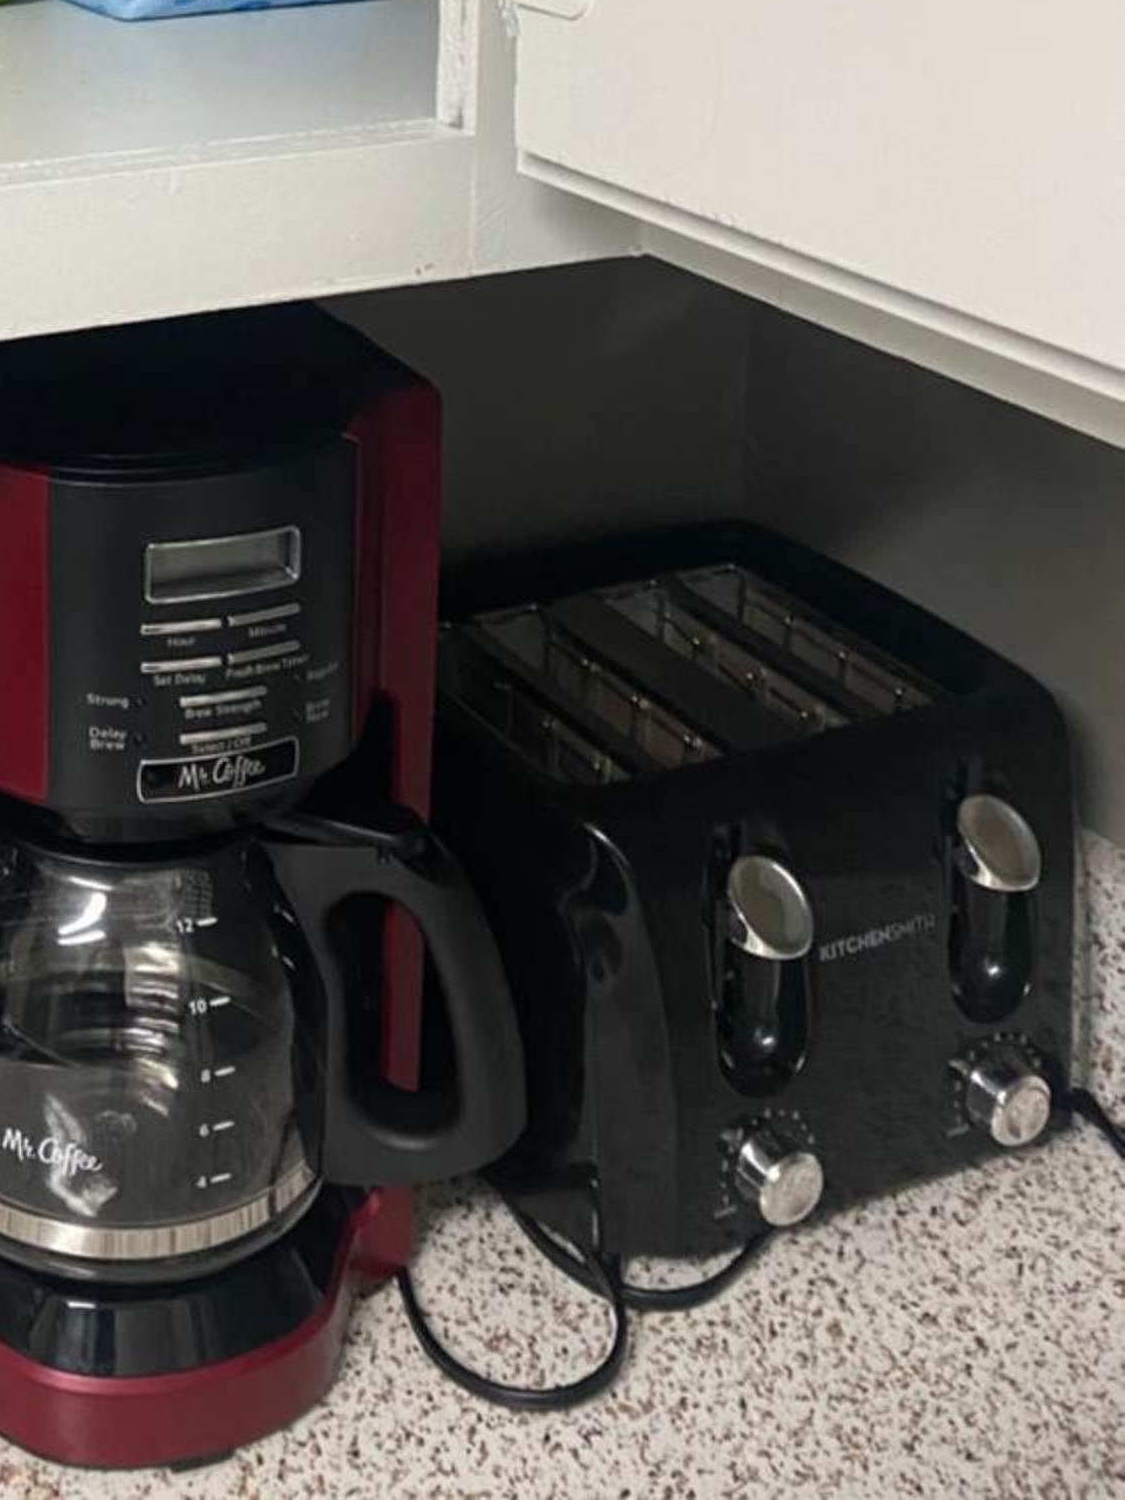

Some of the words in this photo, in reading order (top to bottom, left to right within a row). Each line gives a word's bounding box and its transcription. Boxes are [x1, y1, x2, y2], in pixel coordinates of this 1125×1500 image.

[86, 693, 130, 709] Strong
[88, 726, 127, 741] Delay
[89, 738, 125, 750] Brew
[212, 755, 266, 788] Coffee
[176, 917, 195, 934] 12
[818, 913, 936, 962] KITCHENSMITH
[189, 1000, 208, 1015] 10
[1, 1128, 35, 1163] Mr.
[37, 1136, 104, 1175] Coffee
